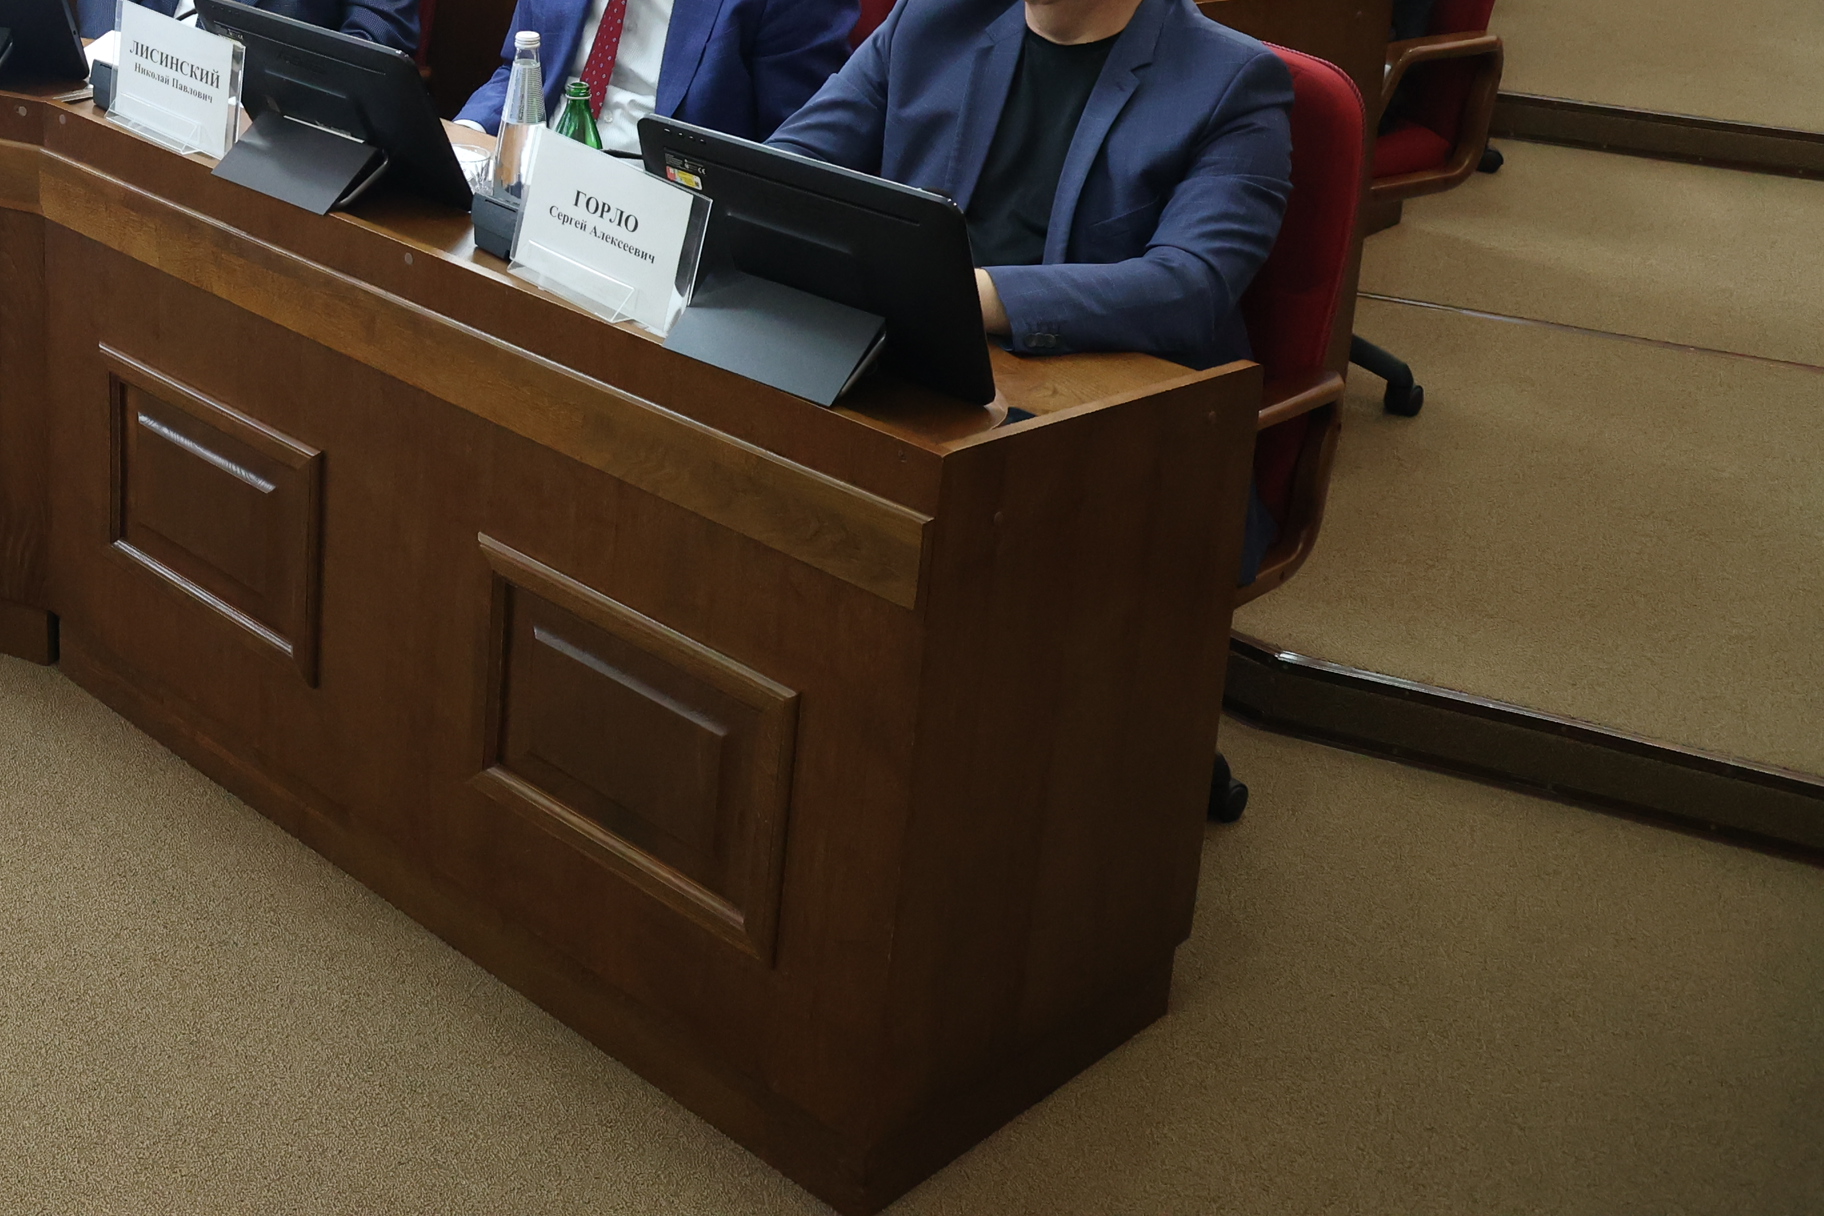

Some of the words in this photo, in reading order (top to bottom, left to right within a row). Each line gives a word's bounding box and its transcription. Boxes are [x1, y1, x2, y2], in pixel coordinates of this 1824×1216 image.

[129, 40, 221, 89] ЛИСИНСКИЙ
[134, 62, 170, 86] Николай
[171, 77, 213, 104] Павлович
[573, 189, 639, 233] ГОРЛО
[549, 205, 588, 233] Сергей
[589, 225, 656, 265] Алексеевич
